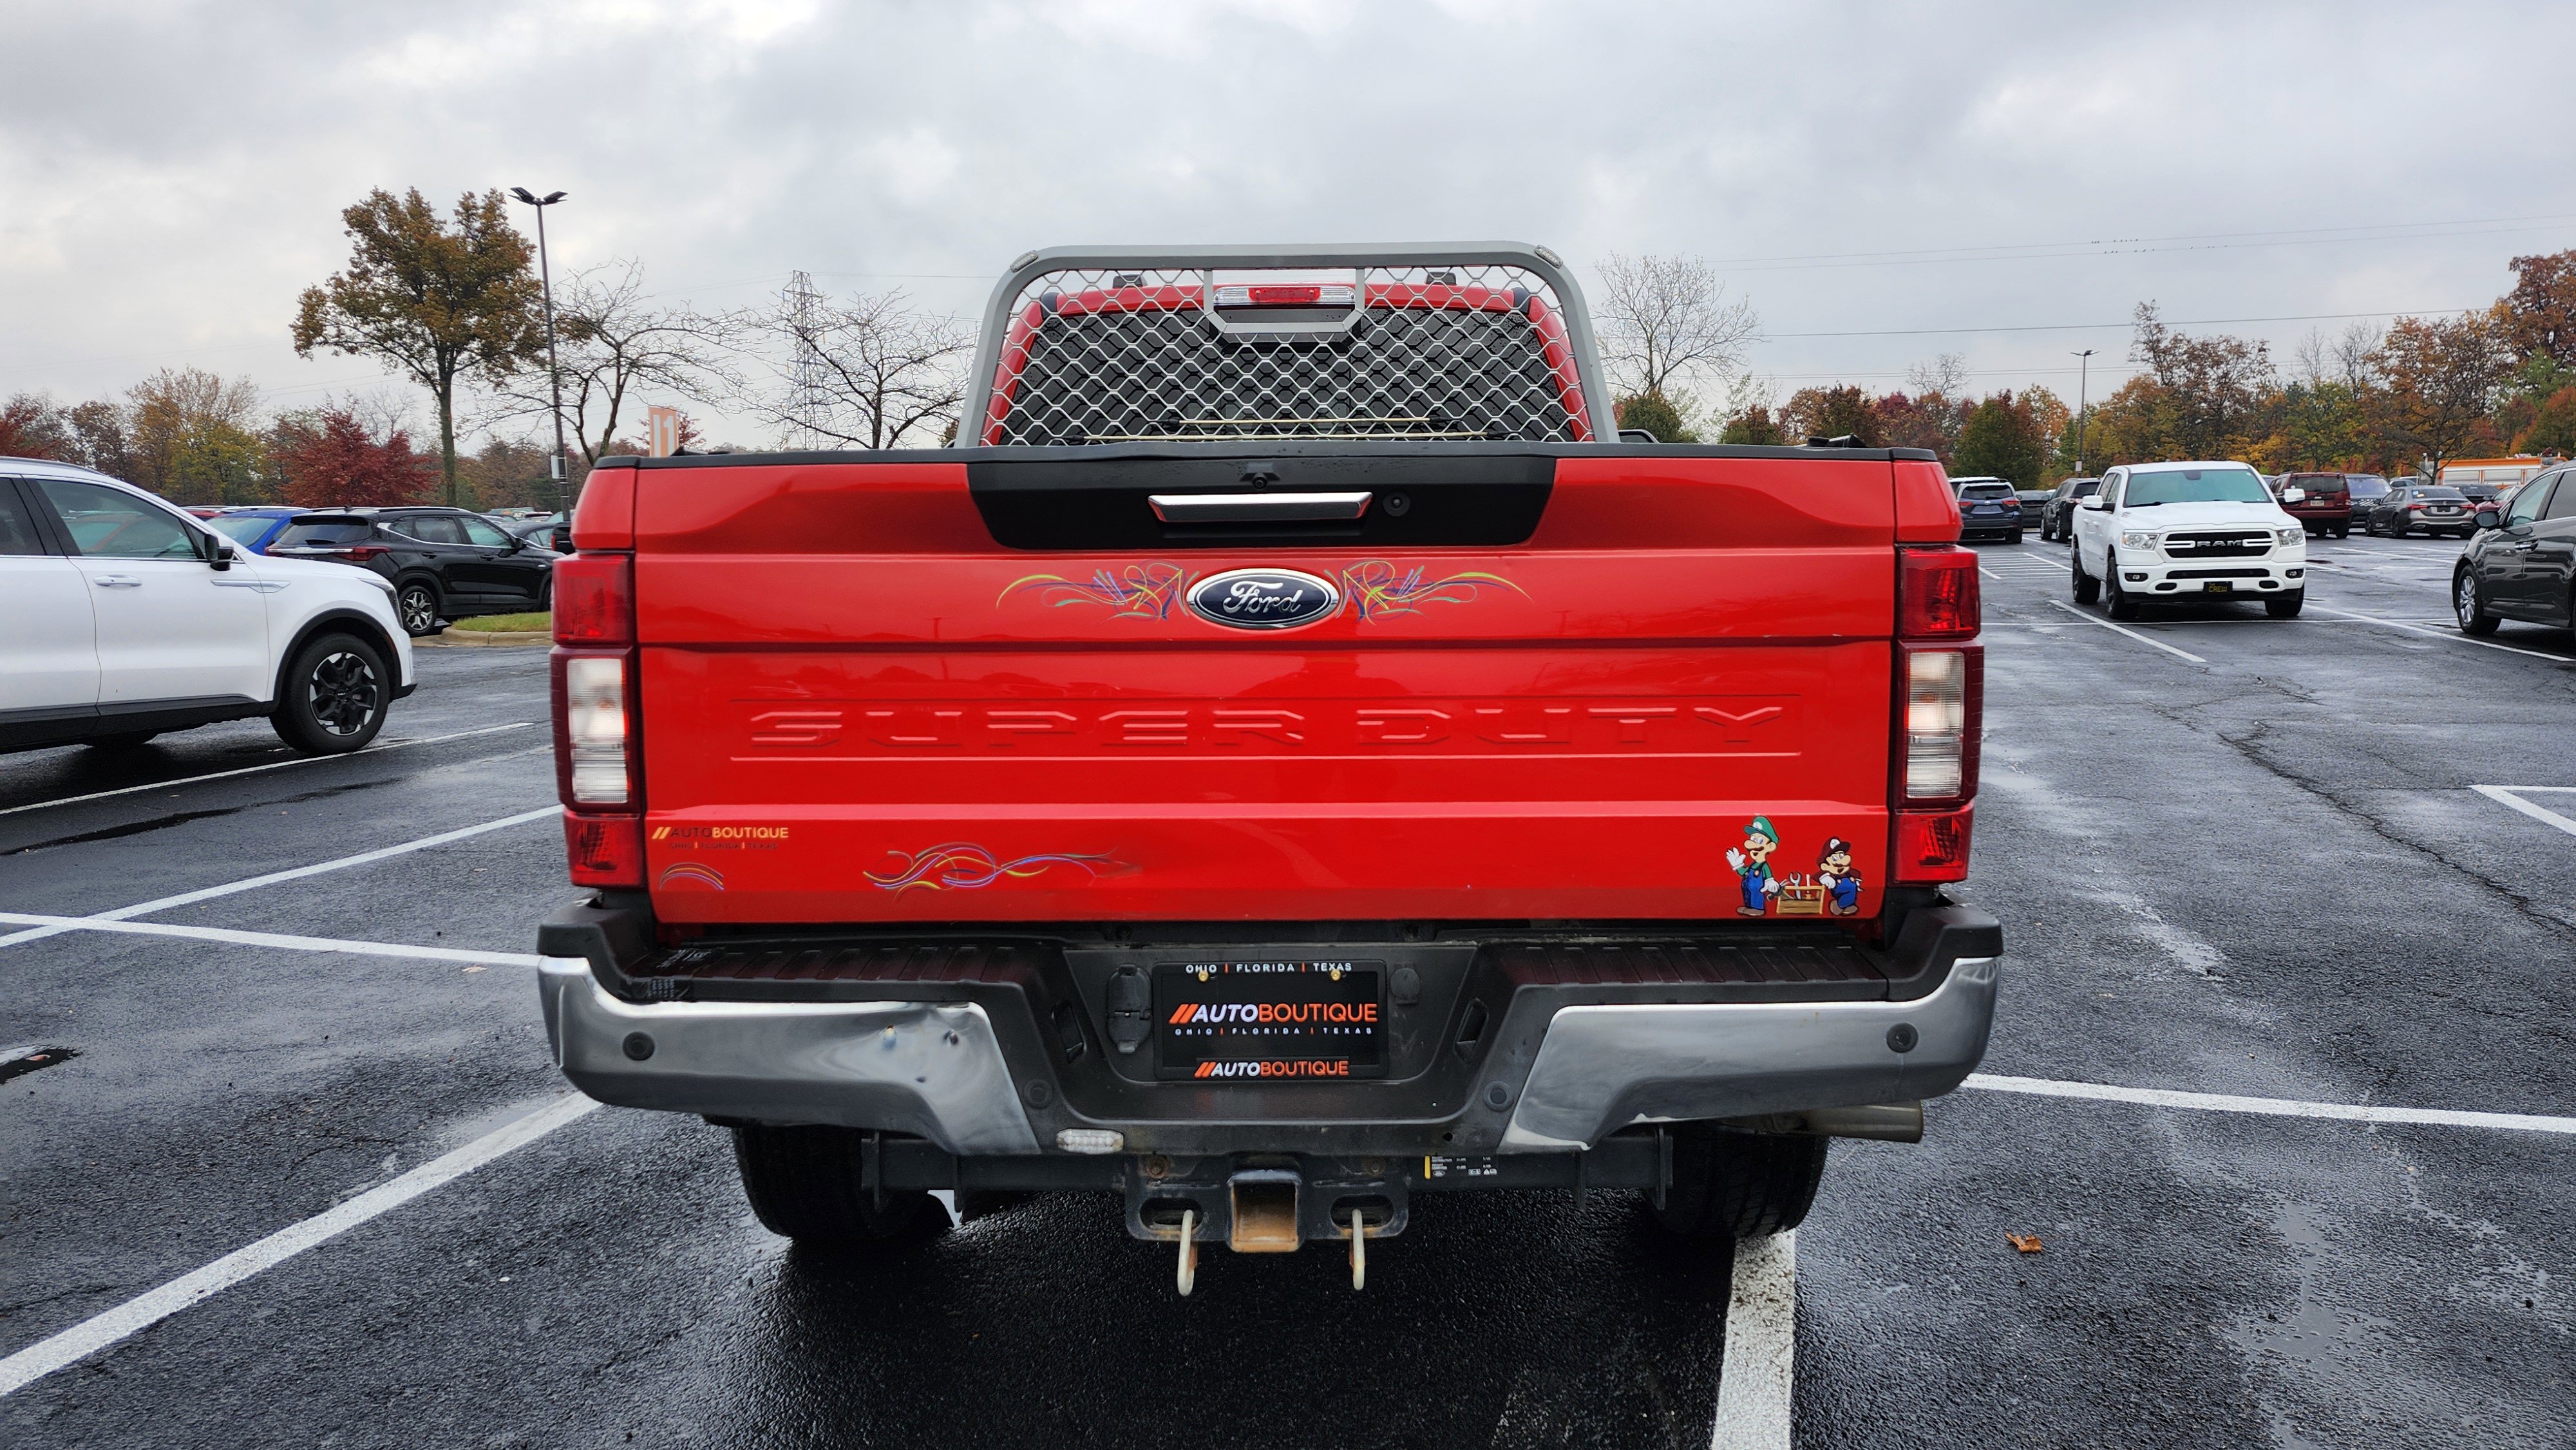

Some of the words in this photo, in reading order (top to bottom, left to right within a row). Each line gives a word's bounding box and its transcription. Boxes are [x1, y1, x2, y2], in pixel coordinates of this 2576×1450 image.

[1223, 581, 1303, 613] Ford
[750, 710, 1305, 747] SUPER
[1356, 707, 1783, 746] DUTY
[670, 827, 789, 838] AUTOBOUTIQUE
[1186, 965, 1217, 974] OHIO
[1236, 963, 1295, 973] FLORIDA
[1313, 963, 1352, 972] TEXAS
[1191, 1004, 1378, 1023] AUTOBOUTIQUE
[1211, 1061, 1349, 1078] AUTOBOUTIQUE
